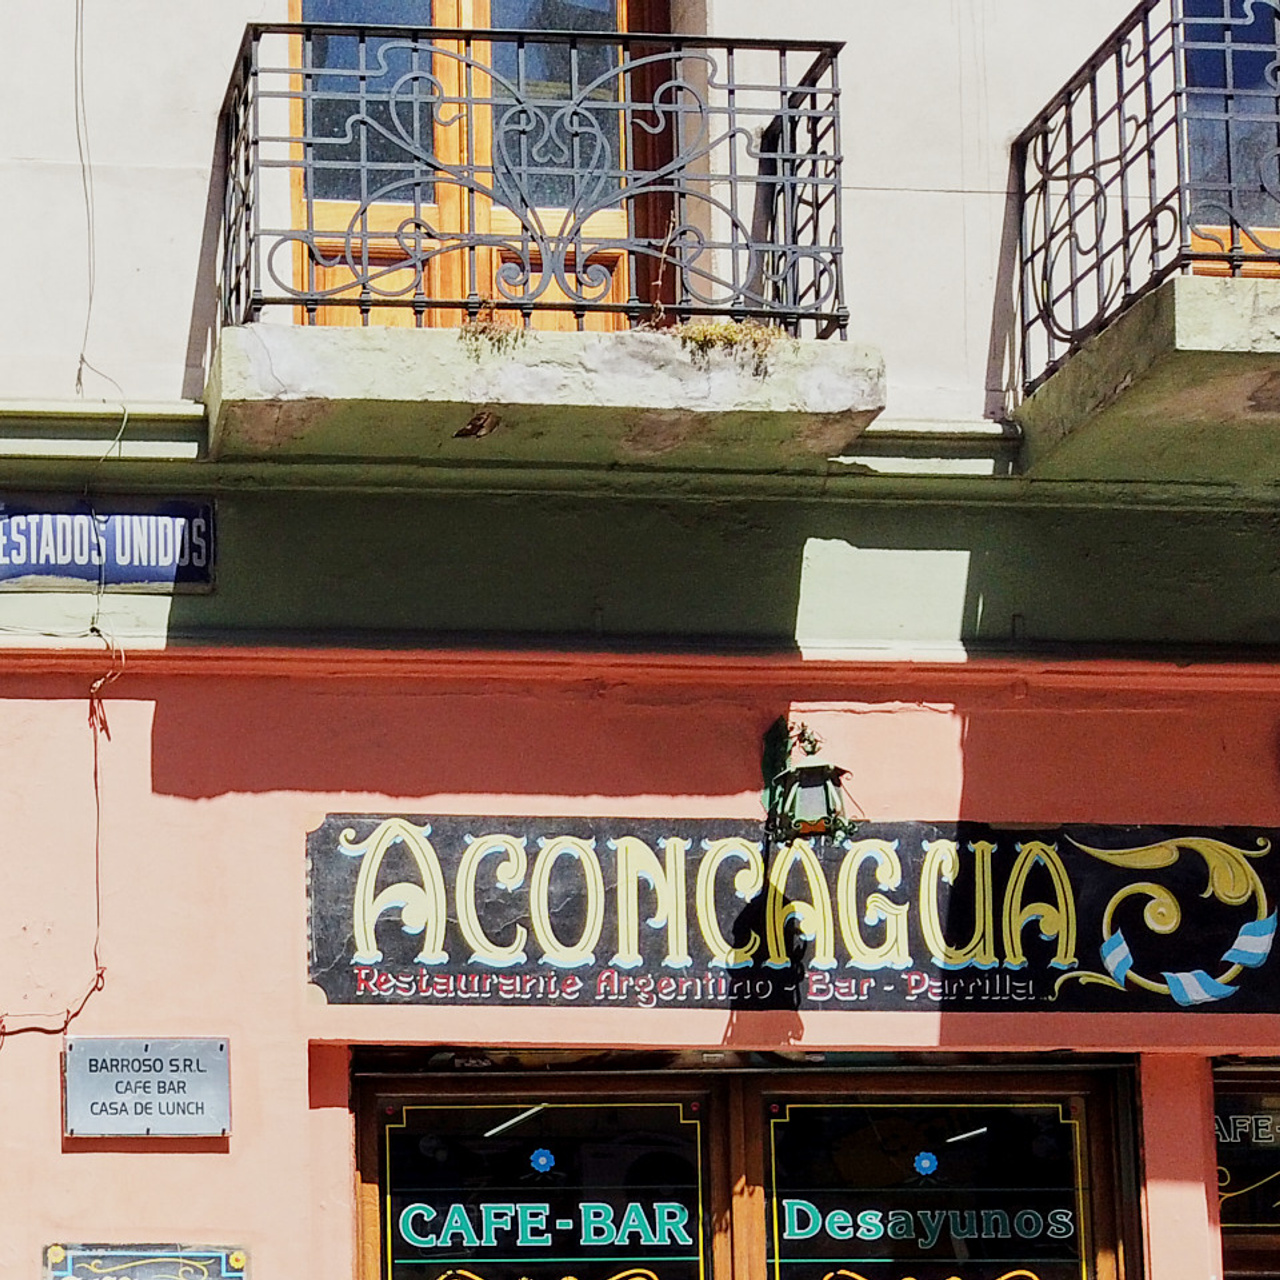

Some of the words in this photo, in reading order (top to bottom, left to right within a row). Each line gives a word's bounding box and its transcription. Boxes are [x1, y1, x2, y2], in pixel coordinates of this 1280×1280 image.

[114, 514, 207, 567] UNIDOS
[337, 816, 1080, 971] ACONCAGUA
[353, 966, 583, 1000] Restaurante
[595, 968, 773, 1007] Argentino
[805, 970, 876, 1001] Bar
[900, 970, 1036, 1001] Parrilla
[88, 1058, 164, 1074] BARROSO
[115, 1080, 152, 1095] CAFE
[157, 1080, 187, 1095] BAR
[90, 1101, 129, 1116] CASA
[133, 1101, 153, 1116] DE
[158, 1101, 205, 1116] LUNCH
[1214, 1115, 1280, 1143] AFE-
[398, 1202, 693, 1248] CAFE-BAR
[781, 1198, 1075, 1250] Desayunos
